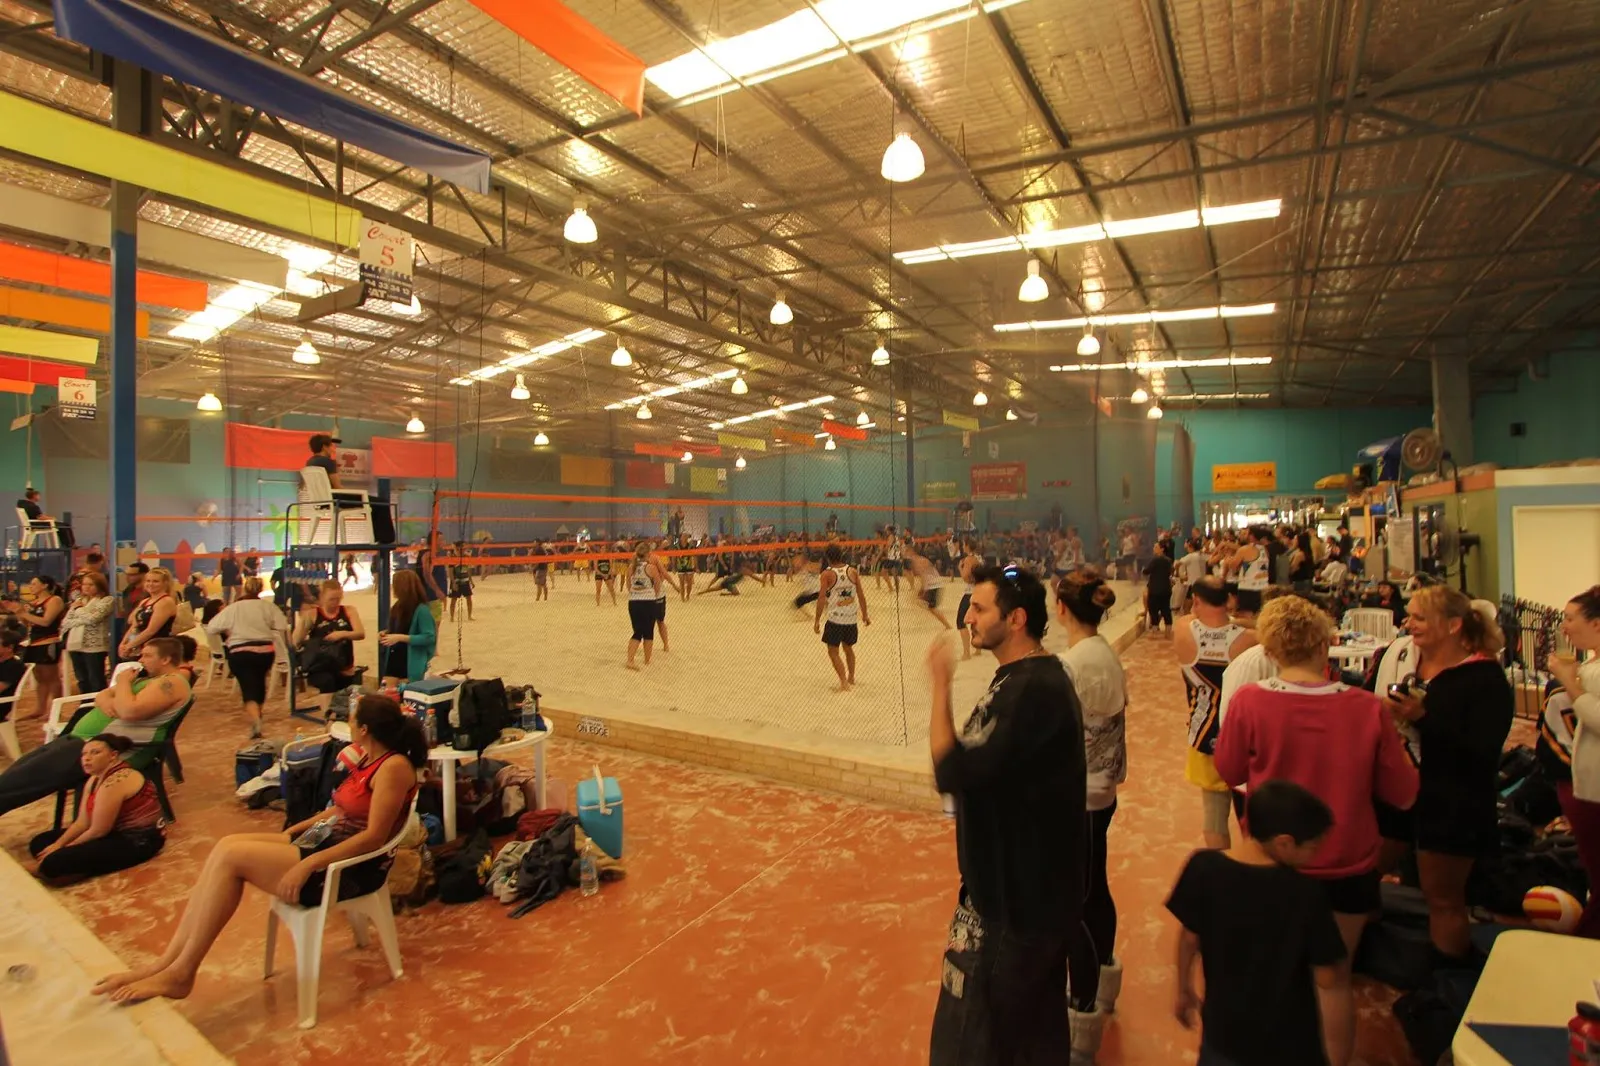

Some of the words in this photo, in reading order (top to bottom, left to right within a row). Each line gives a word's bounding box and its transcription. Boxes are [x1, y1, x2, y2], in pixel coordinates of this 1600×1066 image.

[367, 225, 405, 246] Court
[380, 245, 395, 267] 5
[63, 380, 92, 388] Court
[74, 390, 84, 401] 6
[576, 722, 588, 733] ON
[589, 725, 609, 737] EDGE
